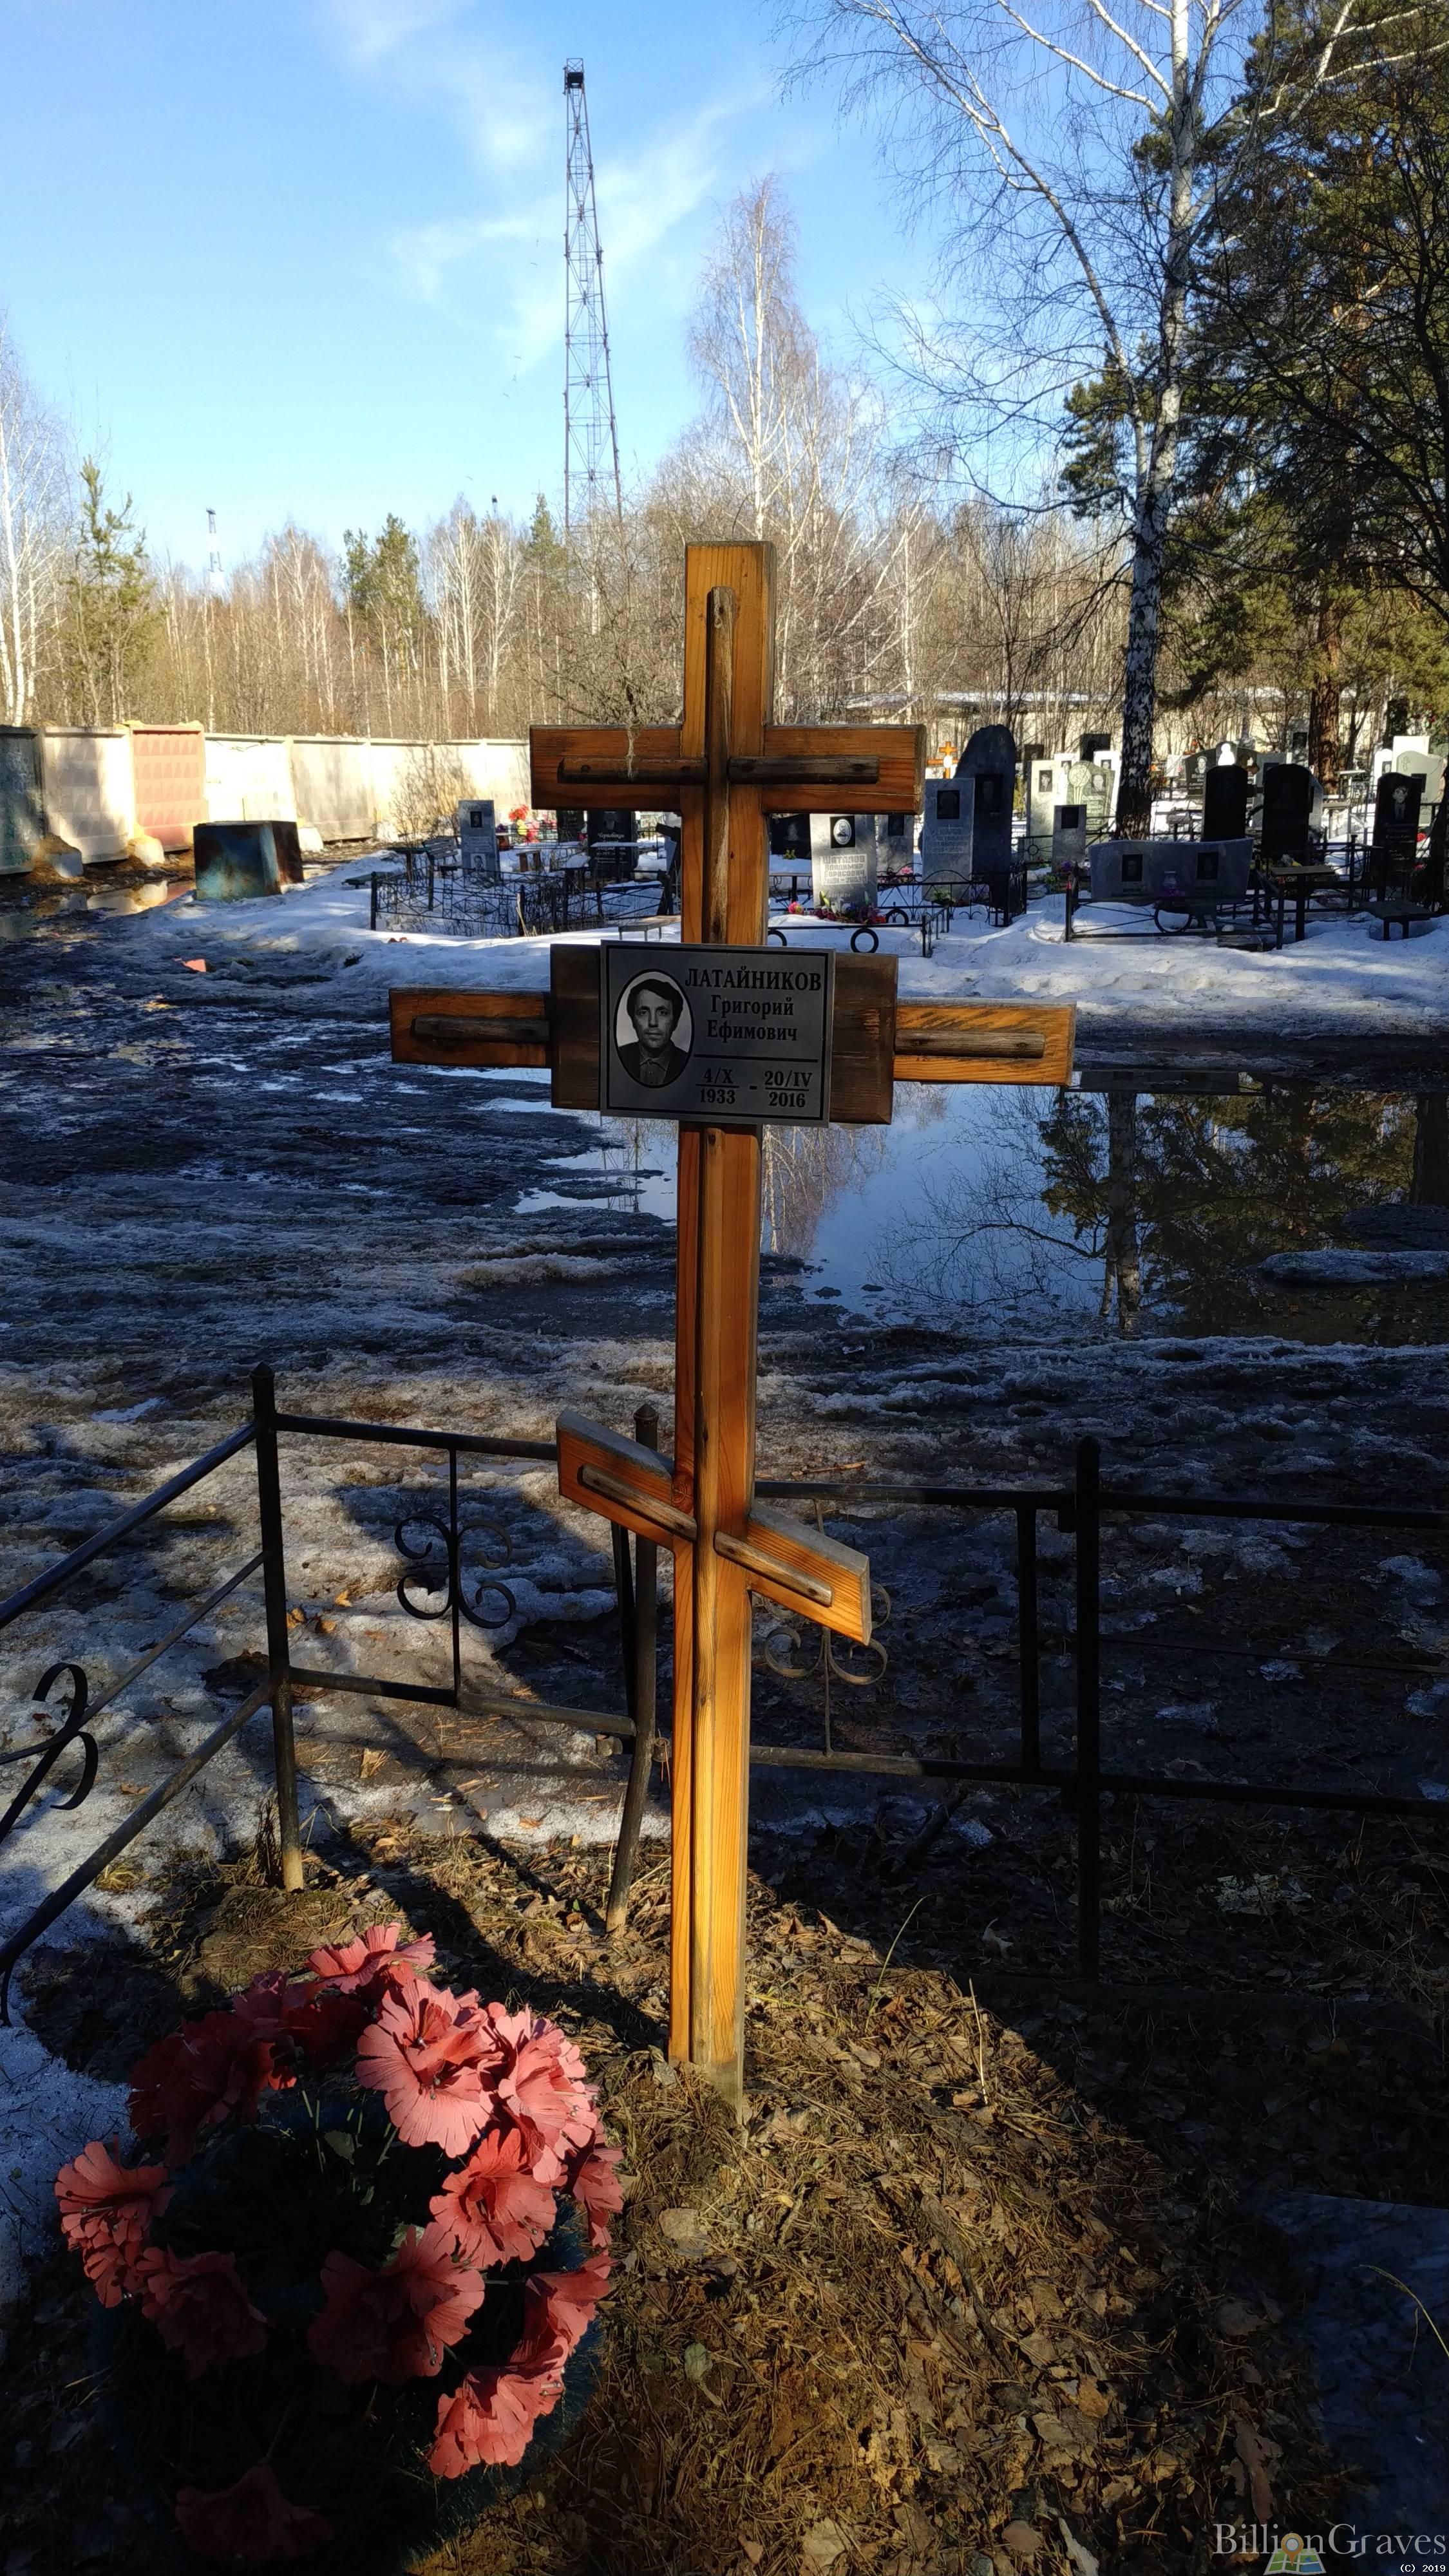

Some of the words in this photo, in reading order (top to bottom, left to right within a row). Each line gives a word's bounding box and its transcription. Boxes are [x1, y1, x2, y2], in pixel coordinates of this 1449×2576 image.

[684, 965, 822, 991] ЛАТАЙНИКОВ
[710, 994, 794, 1019] Григорий
[706, 1019, 797, 1043] Ефимович
[764, 1070, 813, 1087] 20/IV
[699, 1088, 736, 1104] 1933
[768, 1092, 806, 1108] 2016
